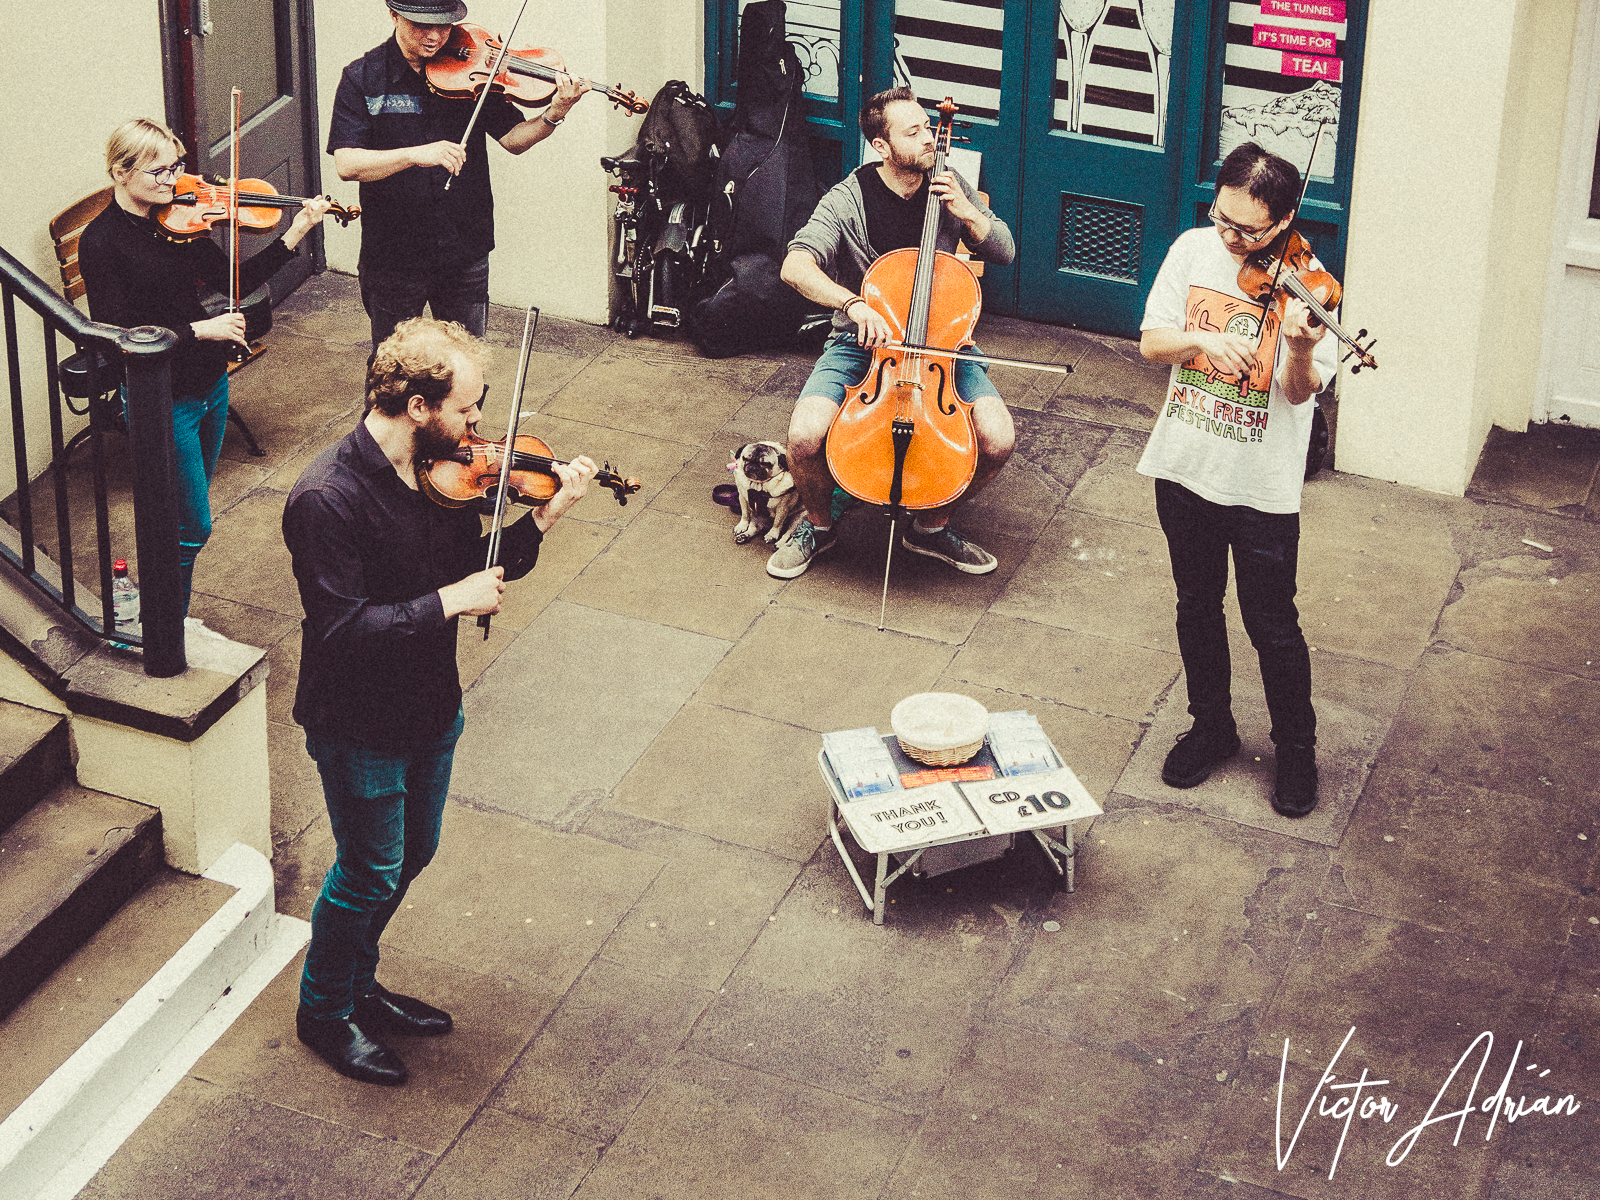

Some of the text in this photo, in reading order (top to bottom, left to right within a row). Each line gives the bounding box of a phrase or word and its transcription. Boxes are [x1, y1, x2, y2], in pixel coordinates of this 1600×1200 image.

[1270, 0, 1335, 17] THE TUNNEL
[1258, 31, 1332, 48] IT'S TIME FOR
[1292, 57, 1328, 75] TEA!
[1169, 385, 1269, 430] N.Y.C. FRESH
[870, 799, 942, 823] THANK
[988, 790, 1072, 818] CD £10
[891, 811, 949, 834] YOU!
